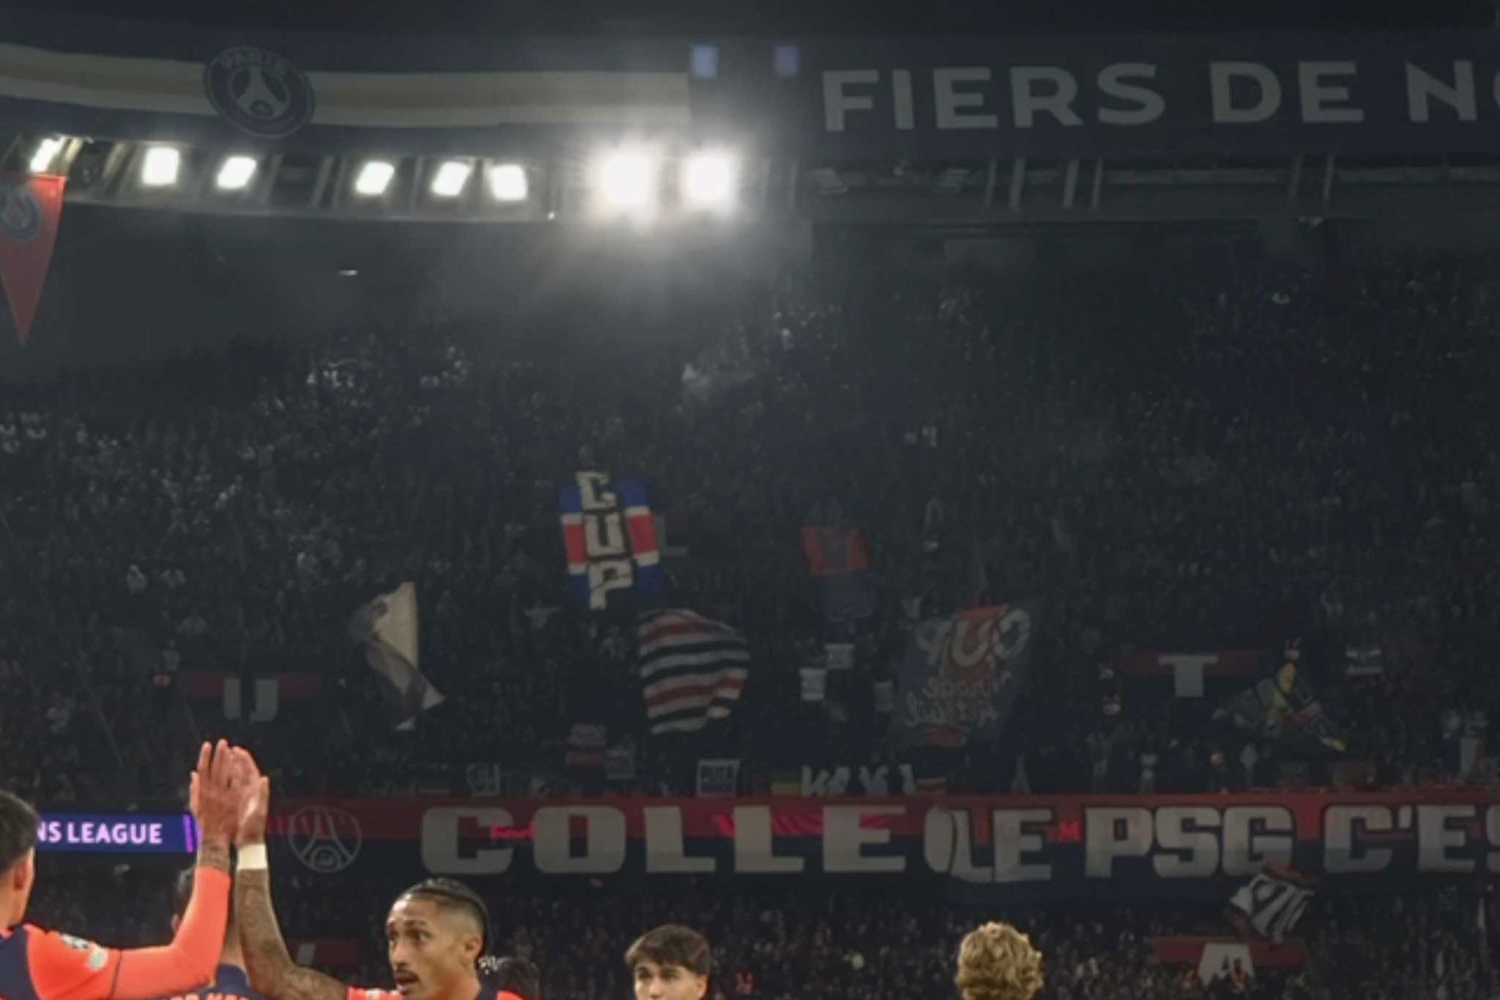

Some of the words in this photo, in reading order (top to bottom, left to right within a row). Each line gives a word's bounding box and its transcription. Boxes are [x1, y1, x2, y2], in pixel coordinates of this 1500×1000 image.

[821, 62, 1167, 131] FIERS
[1208, 60, 1365, 123] DE
[67, 822, 162, 844] LEAGUE
[1084, 806, 1294, 879] PSG
[1322, 804, 1500, 875] C'E
